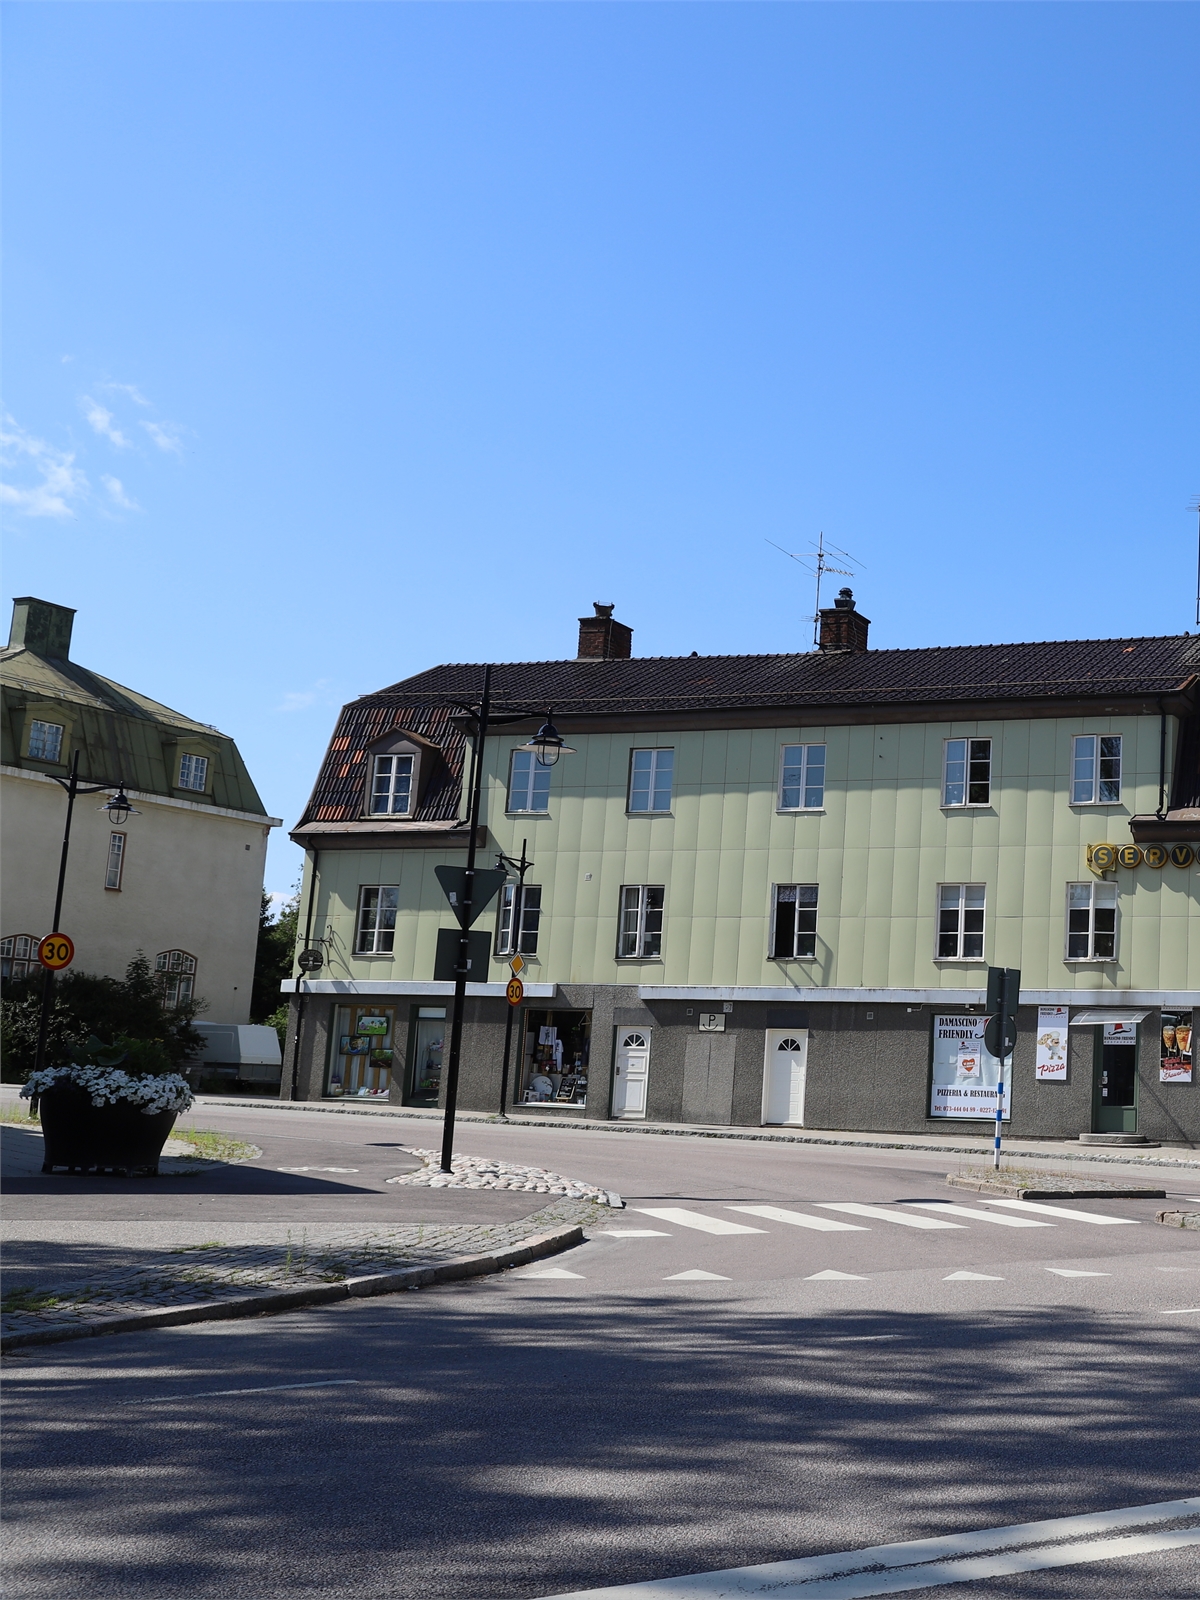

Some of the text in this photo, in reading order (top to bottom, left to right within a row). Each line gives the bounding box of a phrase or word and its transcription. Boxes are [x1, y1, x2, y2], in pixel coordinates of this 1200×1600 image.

[44, 942, 69, 961] 30
[509, 984, 521, 999] 30
[708, 1014, 717, 1028] P
[939, 1017, 978, 1028] DAMASCINO
[938, 1029, 974, 1039] FRIENDLY
[937, 1089, 962, 1097] PIZZERIA
[970, 1090, 1006, 1098] RESTAURAG
